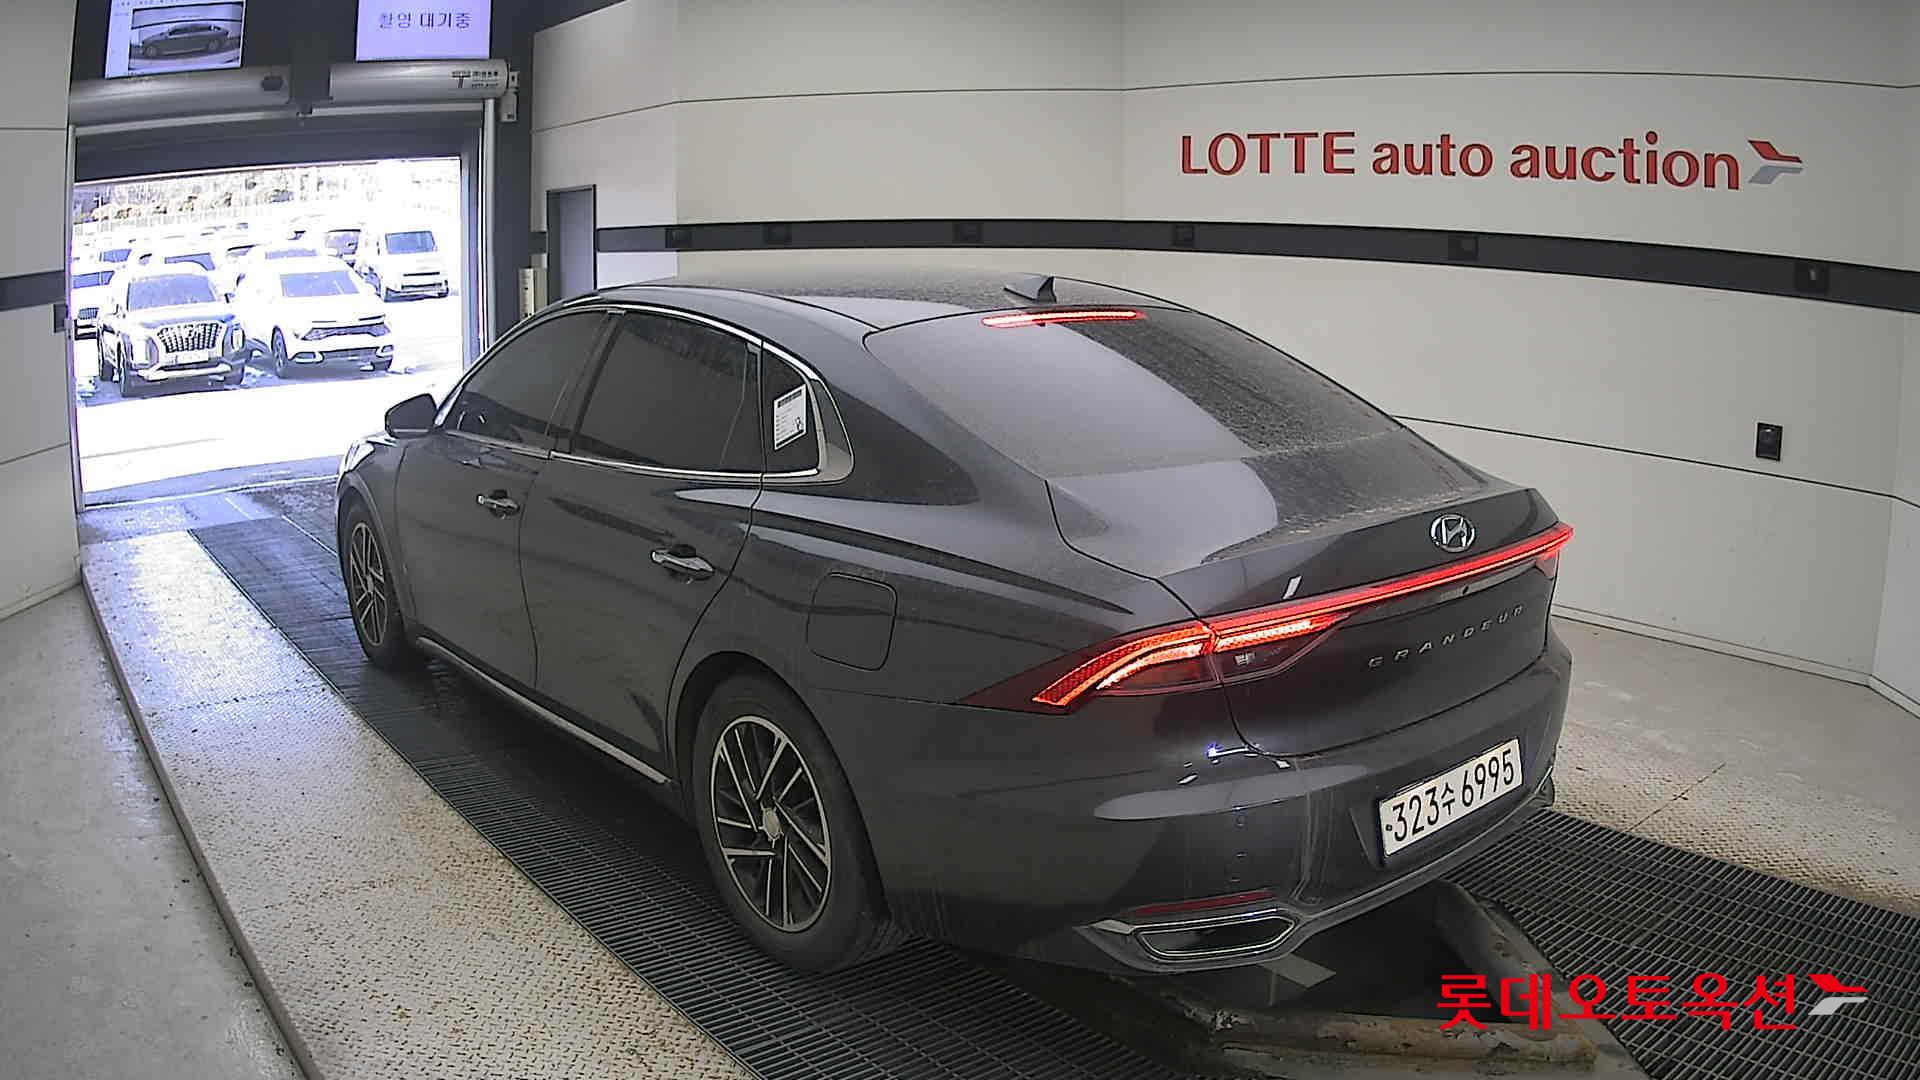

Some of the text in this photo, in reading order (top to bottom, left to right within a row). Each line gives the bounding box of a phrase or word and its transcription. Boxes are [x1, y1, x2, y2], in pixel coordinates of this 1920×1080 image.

[420, 12, 473, 29] 대기중
[1181, 130, 1740, 190] LOTTE auto auction
[1367, 604, 1524, 669] GRANDEUR
[1461, 748, 1515, 808] 6995
